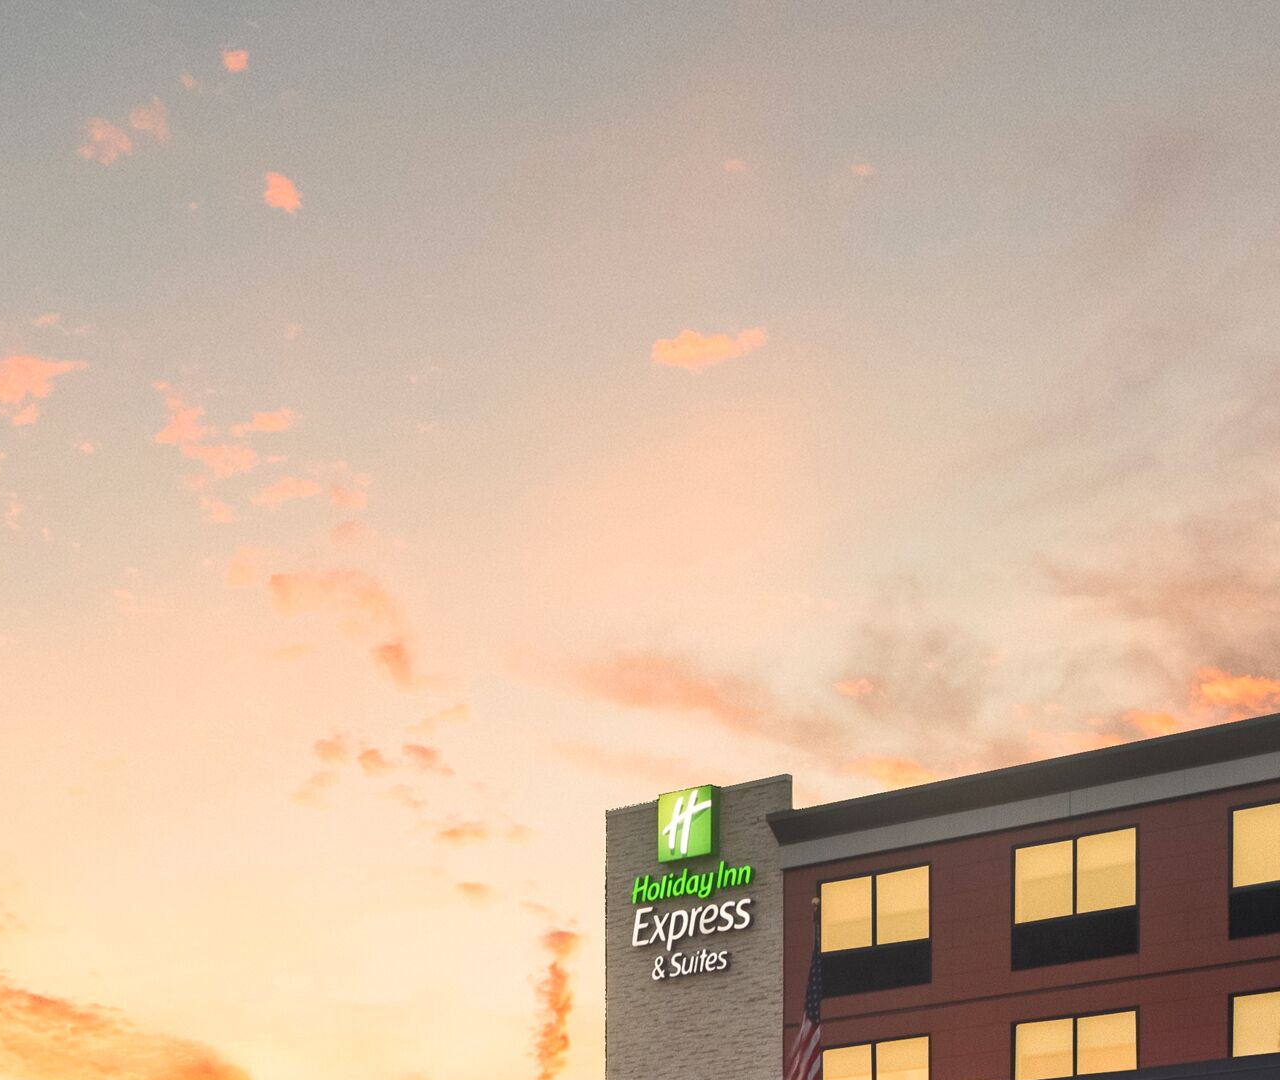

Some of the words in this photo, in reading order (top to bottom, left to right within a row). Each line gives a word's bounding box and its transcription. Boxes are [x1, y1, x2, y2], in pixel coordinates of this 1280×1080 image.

[662, 789, 712, 855] H
[632, 868, 714, 905] Holiday
[716, 860, 752, 889] Inn
[631, 898, 752, 951] Express
[651, 955, 665, 981] &
[669, 949, 728, 977] Suites
